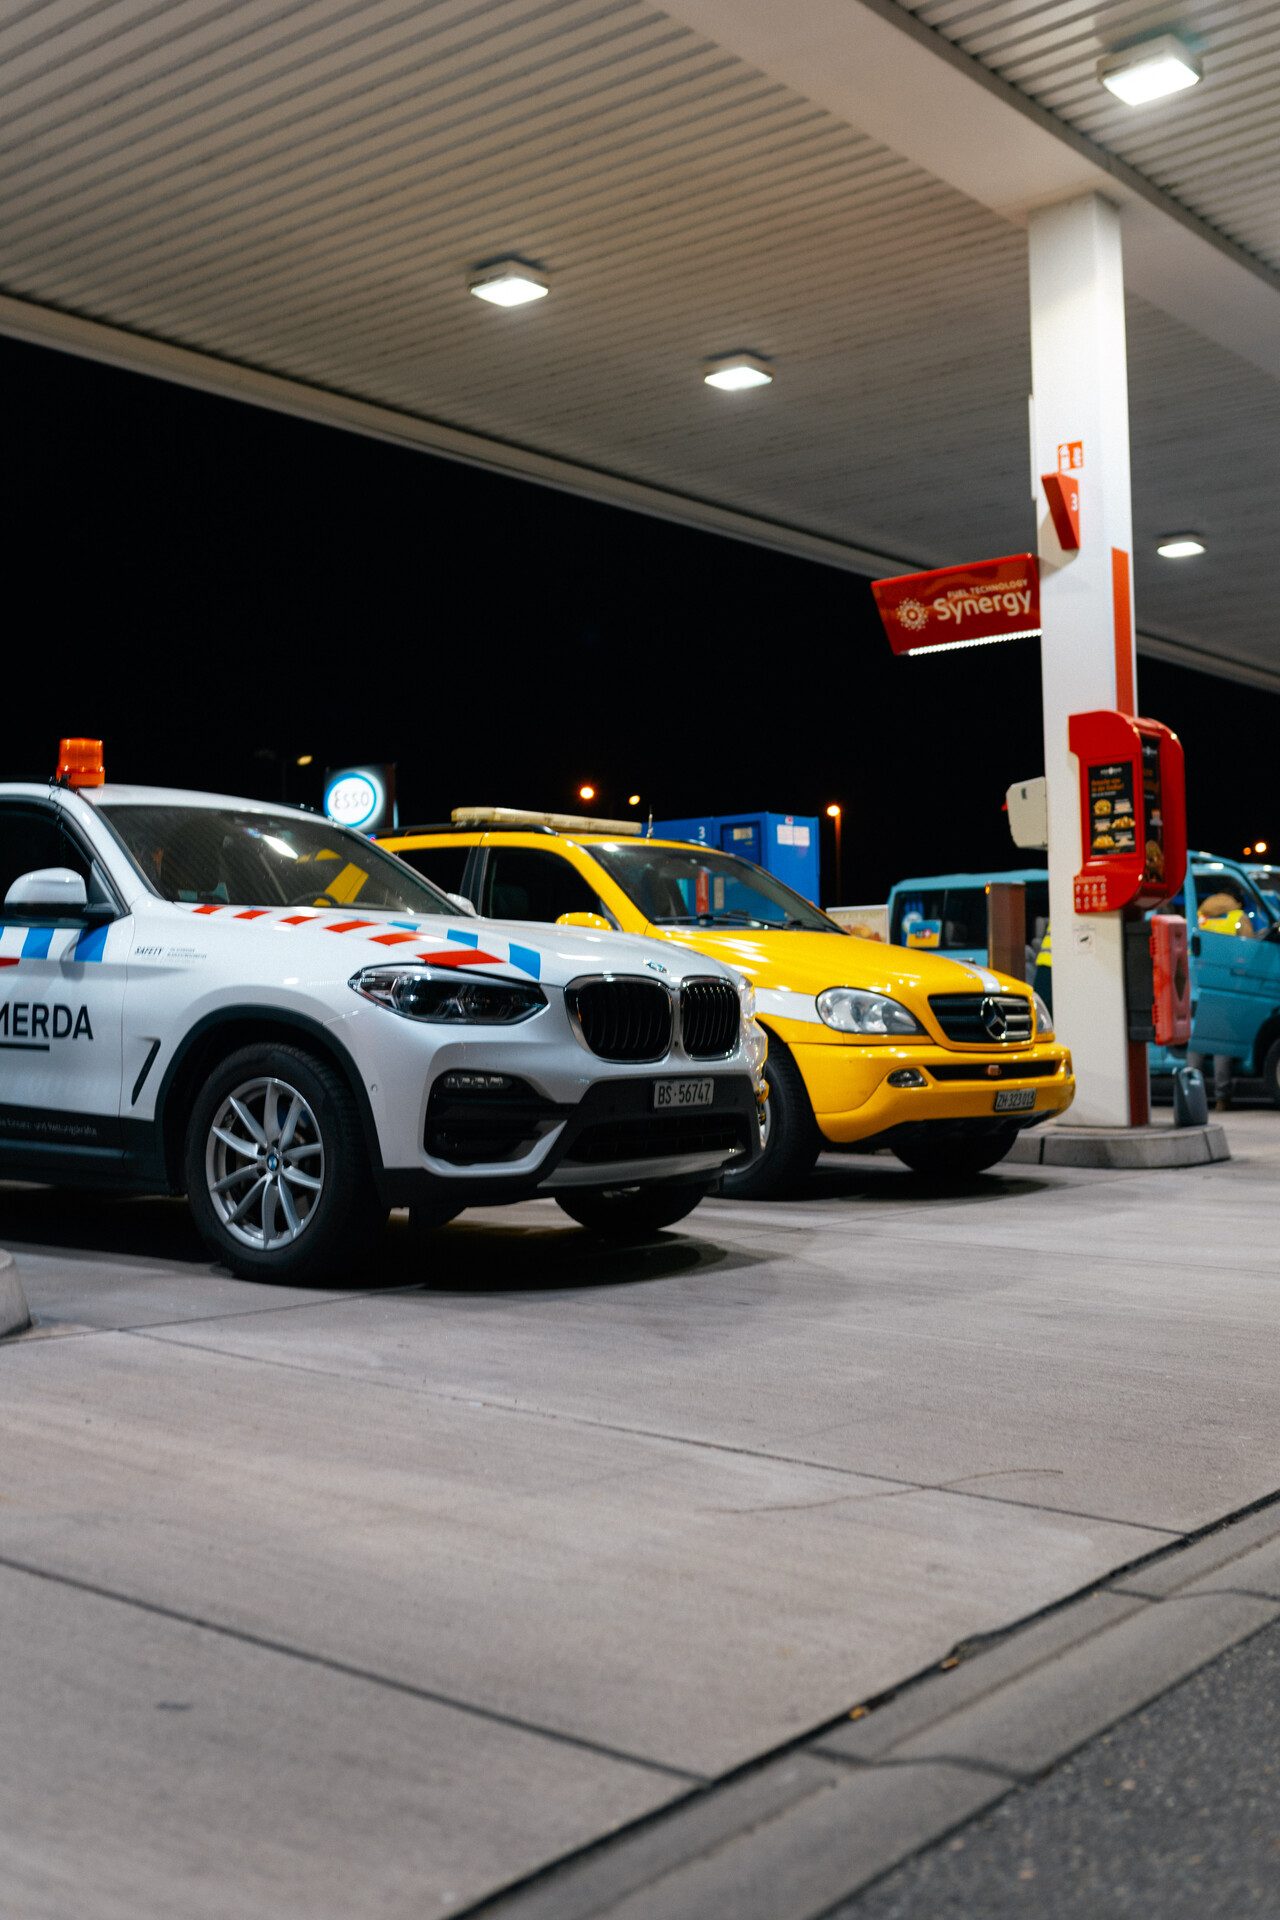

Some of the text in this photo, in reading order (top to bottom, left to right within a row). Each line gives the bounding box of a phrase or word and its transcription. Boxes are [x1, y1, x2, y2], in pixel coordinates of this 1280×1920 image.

[947, 579, 1028, 599] FUEL TECHNOLOGY
[933, 590, 1032, 624] Synergy
[698, 826, 705, 839] 3
